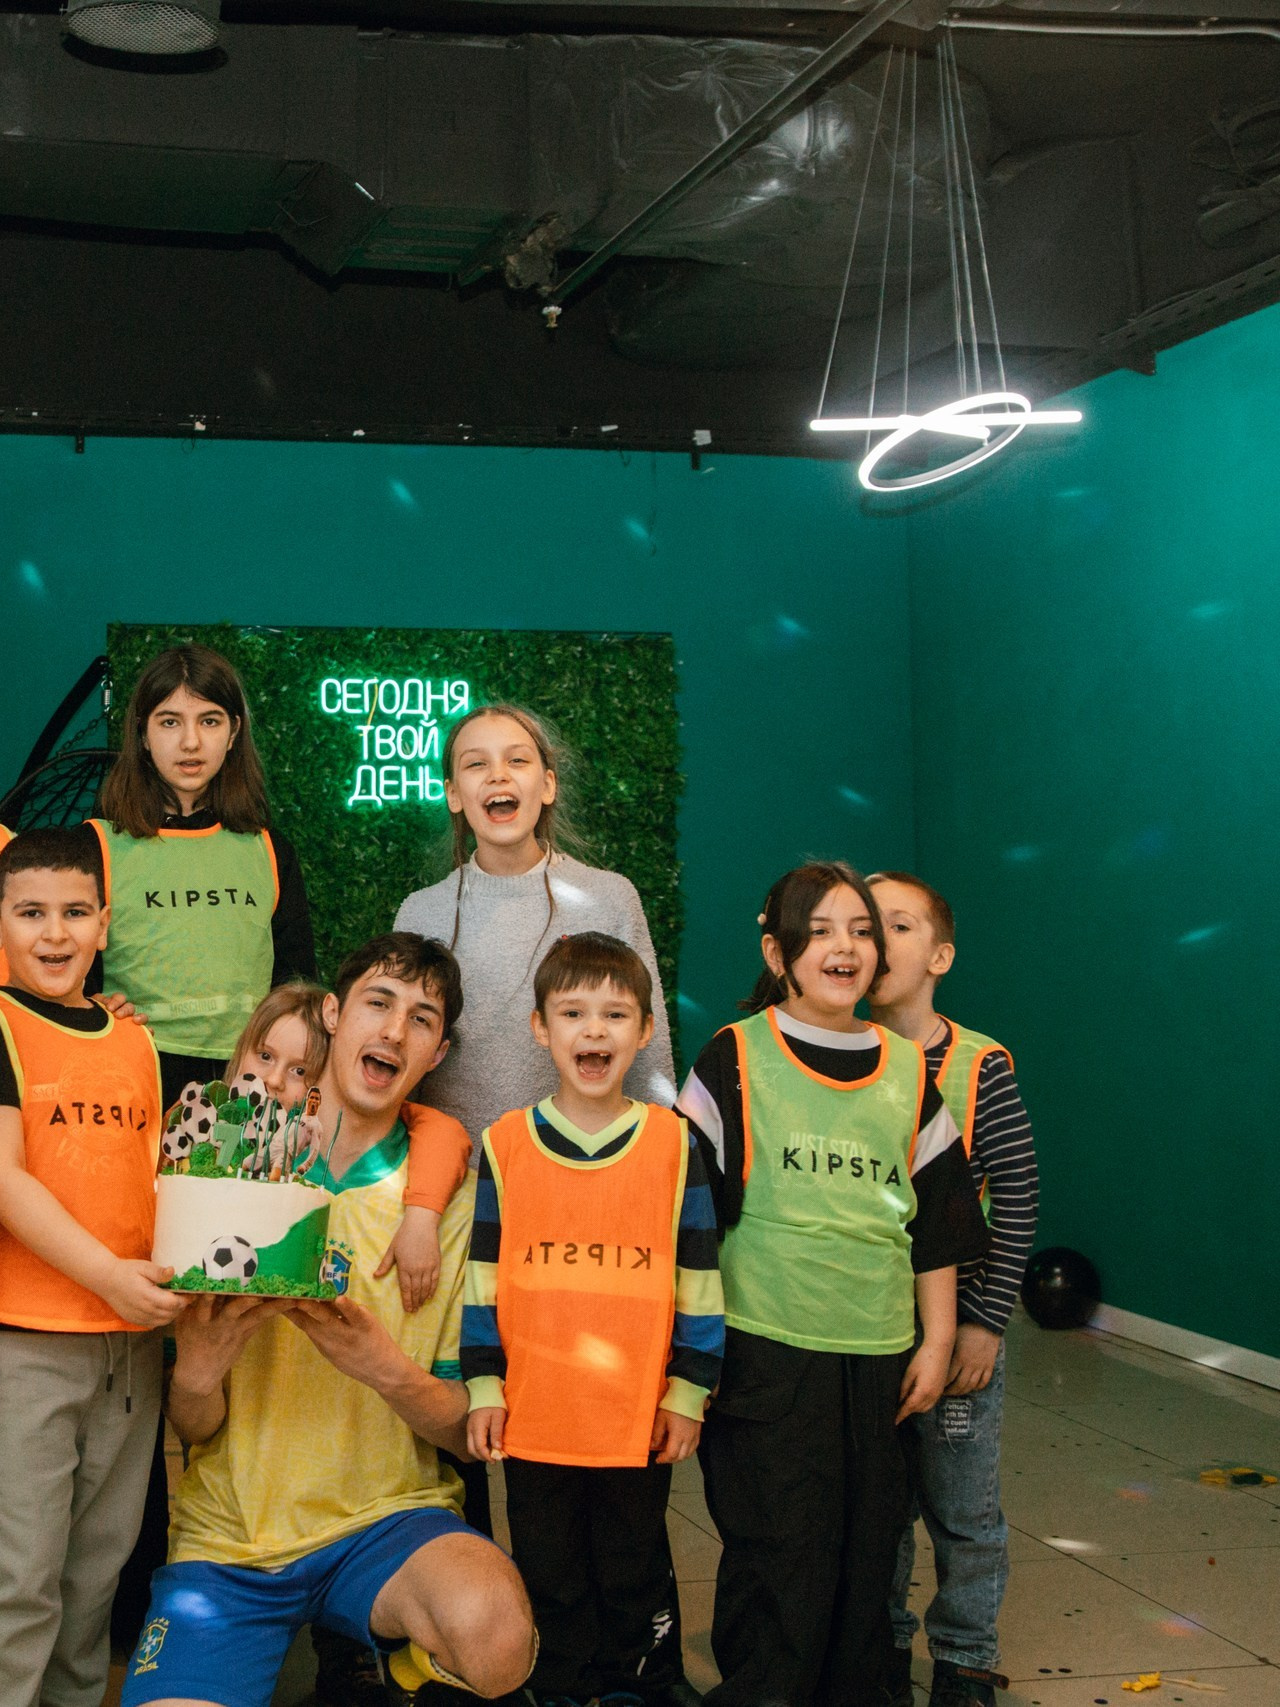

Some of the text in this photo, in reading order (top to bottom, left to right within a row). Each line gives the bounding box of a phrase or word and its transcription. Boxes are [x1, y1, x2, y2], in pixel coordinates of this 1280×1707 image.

[320, 678, 469, 720] СЕГОДНЯ
[356, 719, 440, 760] ТВОЙ
[348, 765, 444, 806] ДЕНЬ
[145, 888, 257, 908] KIPSTA
[783, 1146, 901, 1187] KIPSTA
